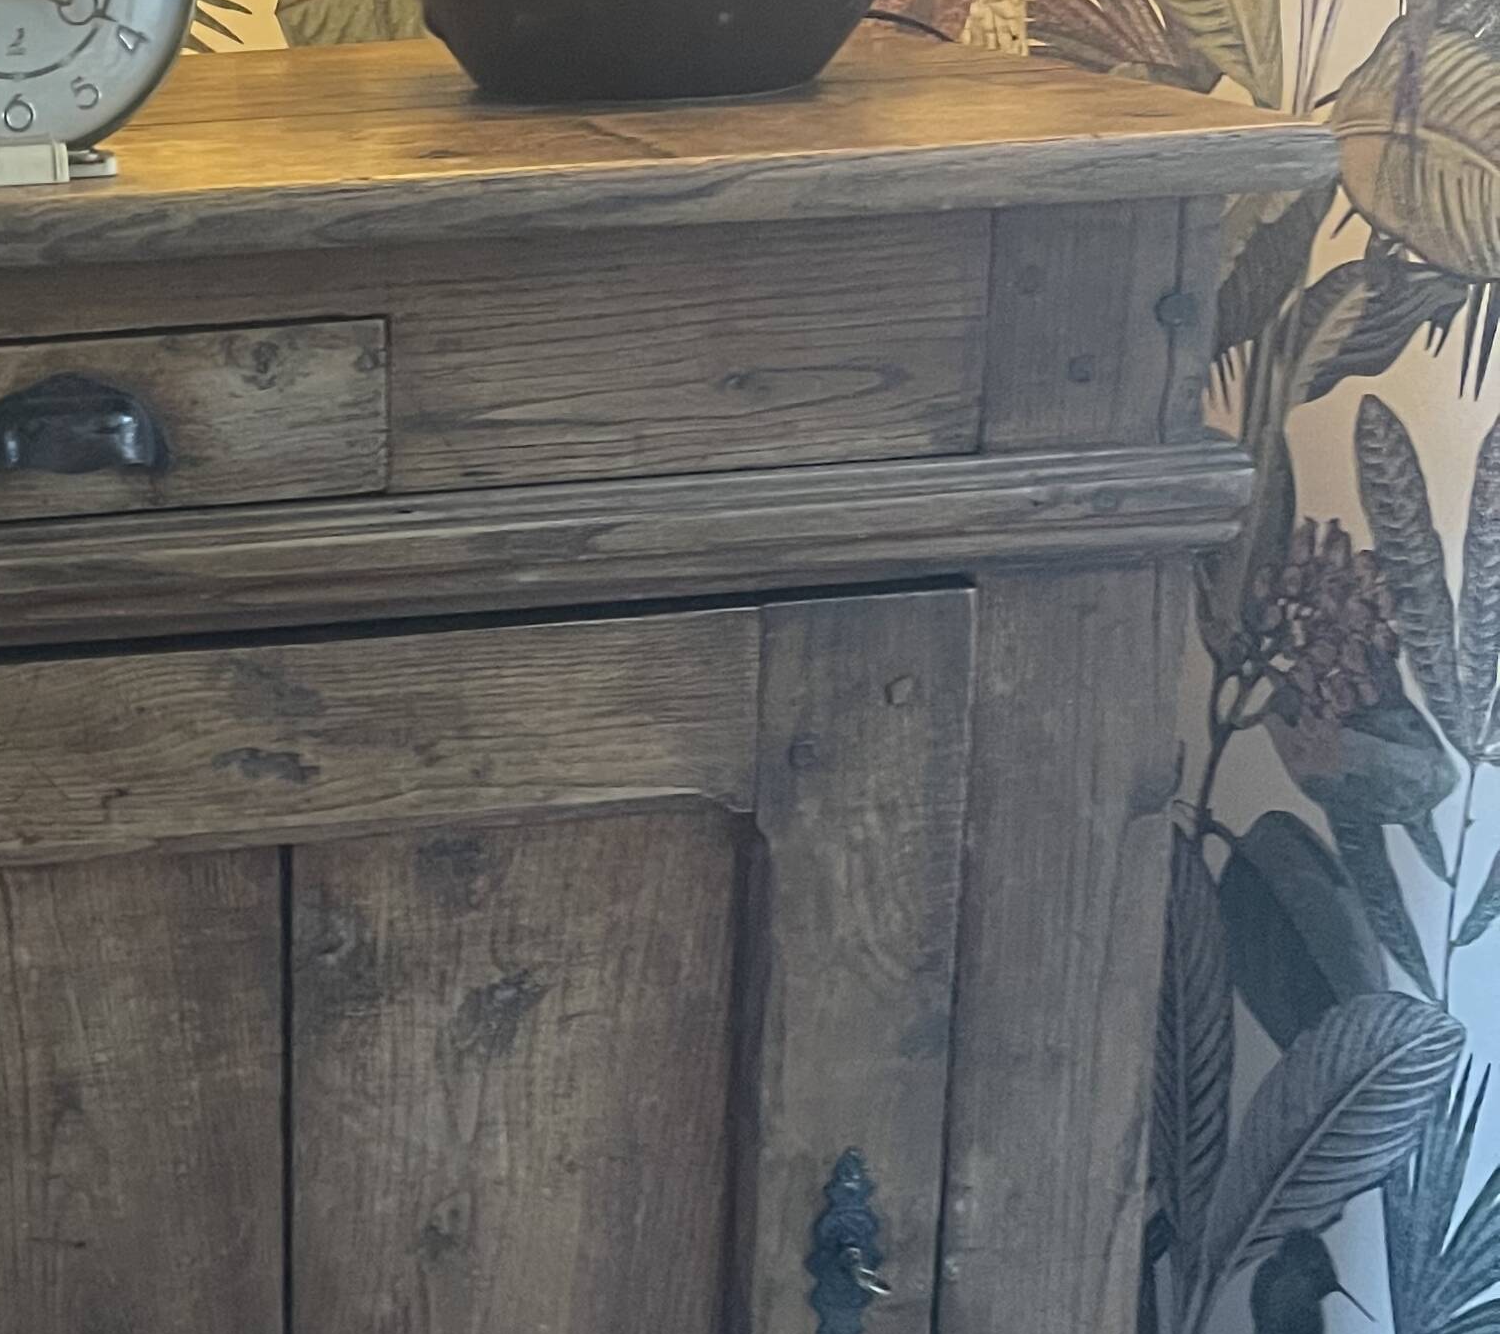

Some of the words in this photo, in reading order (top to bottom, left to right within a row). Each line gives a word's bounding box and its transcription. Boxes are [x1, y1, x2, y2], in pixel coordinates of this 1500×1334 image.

[116, 24, 150, 55] 4
[70, 76, 100, 110] 5
[4, 93, 34, 133] 6
